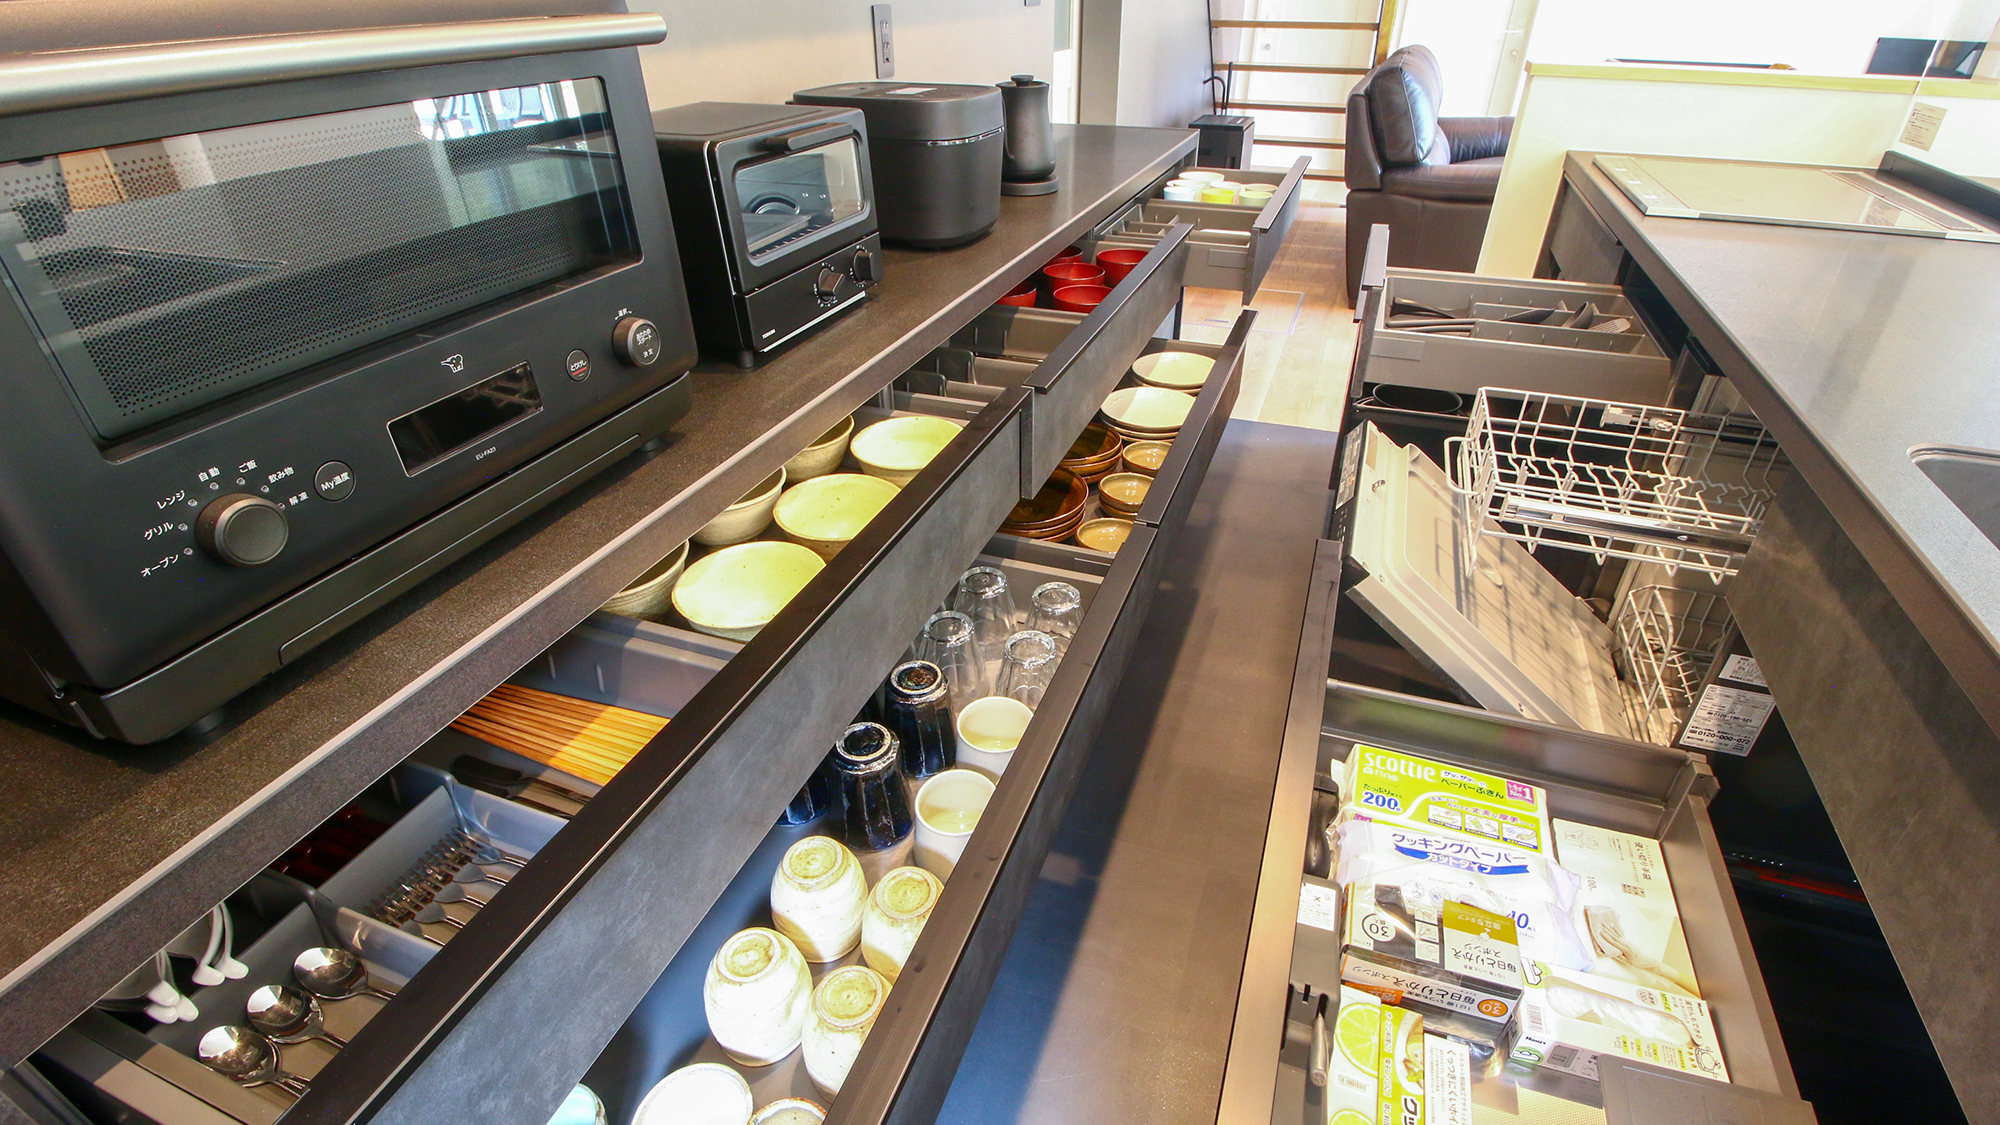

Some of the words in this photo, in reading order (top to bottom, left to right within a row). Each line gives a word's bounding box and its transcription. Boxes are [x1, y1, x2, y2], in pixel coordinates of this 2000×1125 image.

[570, 360, 587, 371] とりけし
[475, 445, 497, 461] EU-FA23
[198, 466, 221, 482] 自動
[238, 459, 258, 473] ご飯
[267, 466, 295, 484] 飲み物
[320, 471, 351, 491] My温度
[156, 489, 186, 510] レンジ
[288, 491, 309, 506] 解凍
[143, 521, 174, 540] グリル
[1374, 768, 1399, 782] fine
[1441, 778, 1505, 799] ペーパーふきん
[1391, 832, 1528, 864] クッキングペーパー
[1634, 841, 1652, 880] 使い切り手袋
[1369, 923, 1390, 938] 30
[1457, 914, 1502, 931] 泡立ちタイプ
[1464, 943, 1502, 958] スポンジ
[1451, 947, 1517, 973] 毎日とりかえ
[1482, 1003, 1503, 1015] 30
[1447, 1049, 1459, 1125] くっつきにくいホイ
